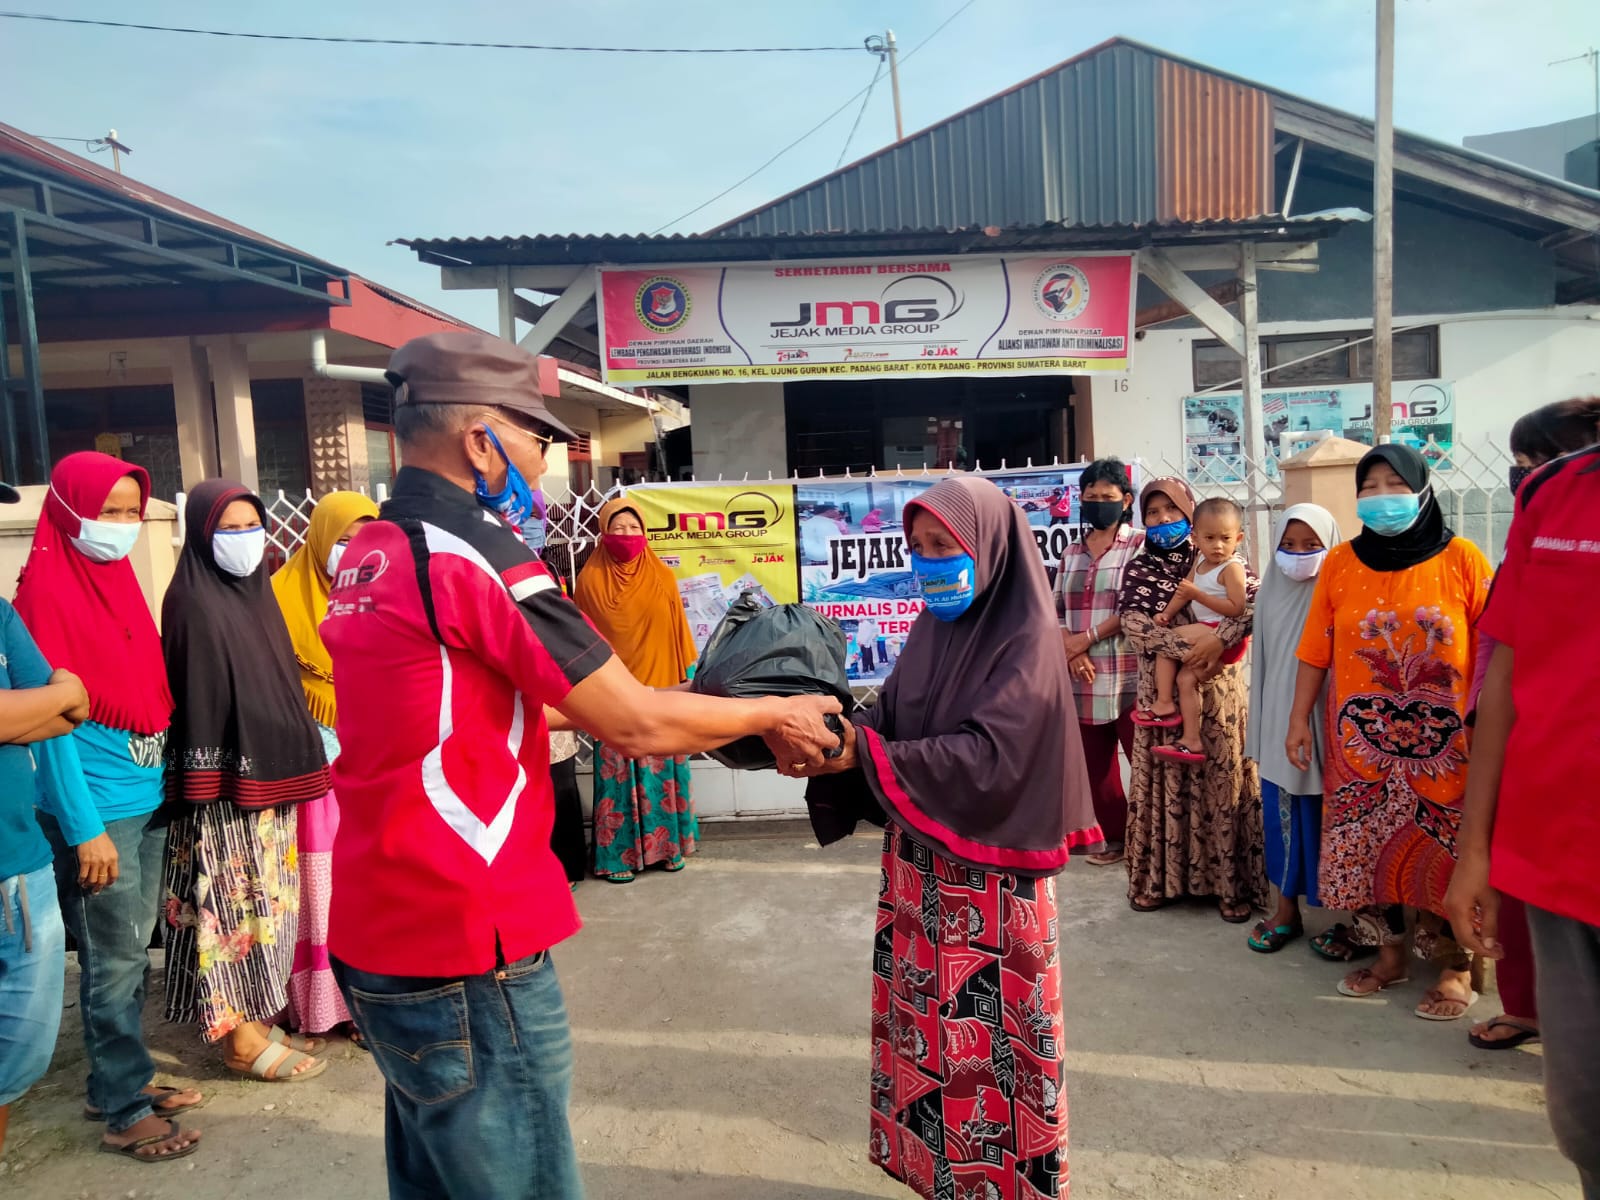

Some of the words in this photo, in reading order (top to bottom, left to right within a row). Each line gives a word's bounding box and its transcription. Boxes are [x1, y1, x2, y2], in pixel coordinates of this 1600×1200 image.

[775, 265, 873, 277] SEKRETARIAT
[877, 263, 952, 274] BERSAMA
[771, 328, 820, 338] JEJAK
[825, 325, 876, 336] MEDIA
[880, 324, 940, 334] GROUP
[998, 339, 1022, 350] ALIANSI
[1024, 338, 1060, 349] WARTAWAN
[1062, 338, 1075, 349] ANTI
[1077, 337, 1123, 350] KRIMINALISASI
[646, 371, 670, 379] JALAN
[672, 370, 720, 378] BENGKUANG
[738, 368, 750, 376] 16,
[771, 367, 798, 375] UJUNG
[800, 366, 828, 374] GURUN
[830, 365, 847, 373] KEC.
[850, 364, 881, 372] PADANG
[883, 363, 909, 371] BARAT
[939, 362, 970, 370] PADANG
[977, 361, 1014, 369] PROVINSI
[1017, 360, 1060, 369] SUMATERA
[1063, 360, 1087, 368] BARAT
[1114, 378, 1129, 392] 16
[647, 532, 684, 541] JEJAK
[686, 531, 723, 539] MEDIA
[725, 530, 768, 538] GROUP
